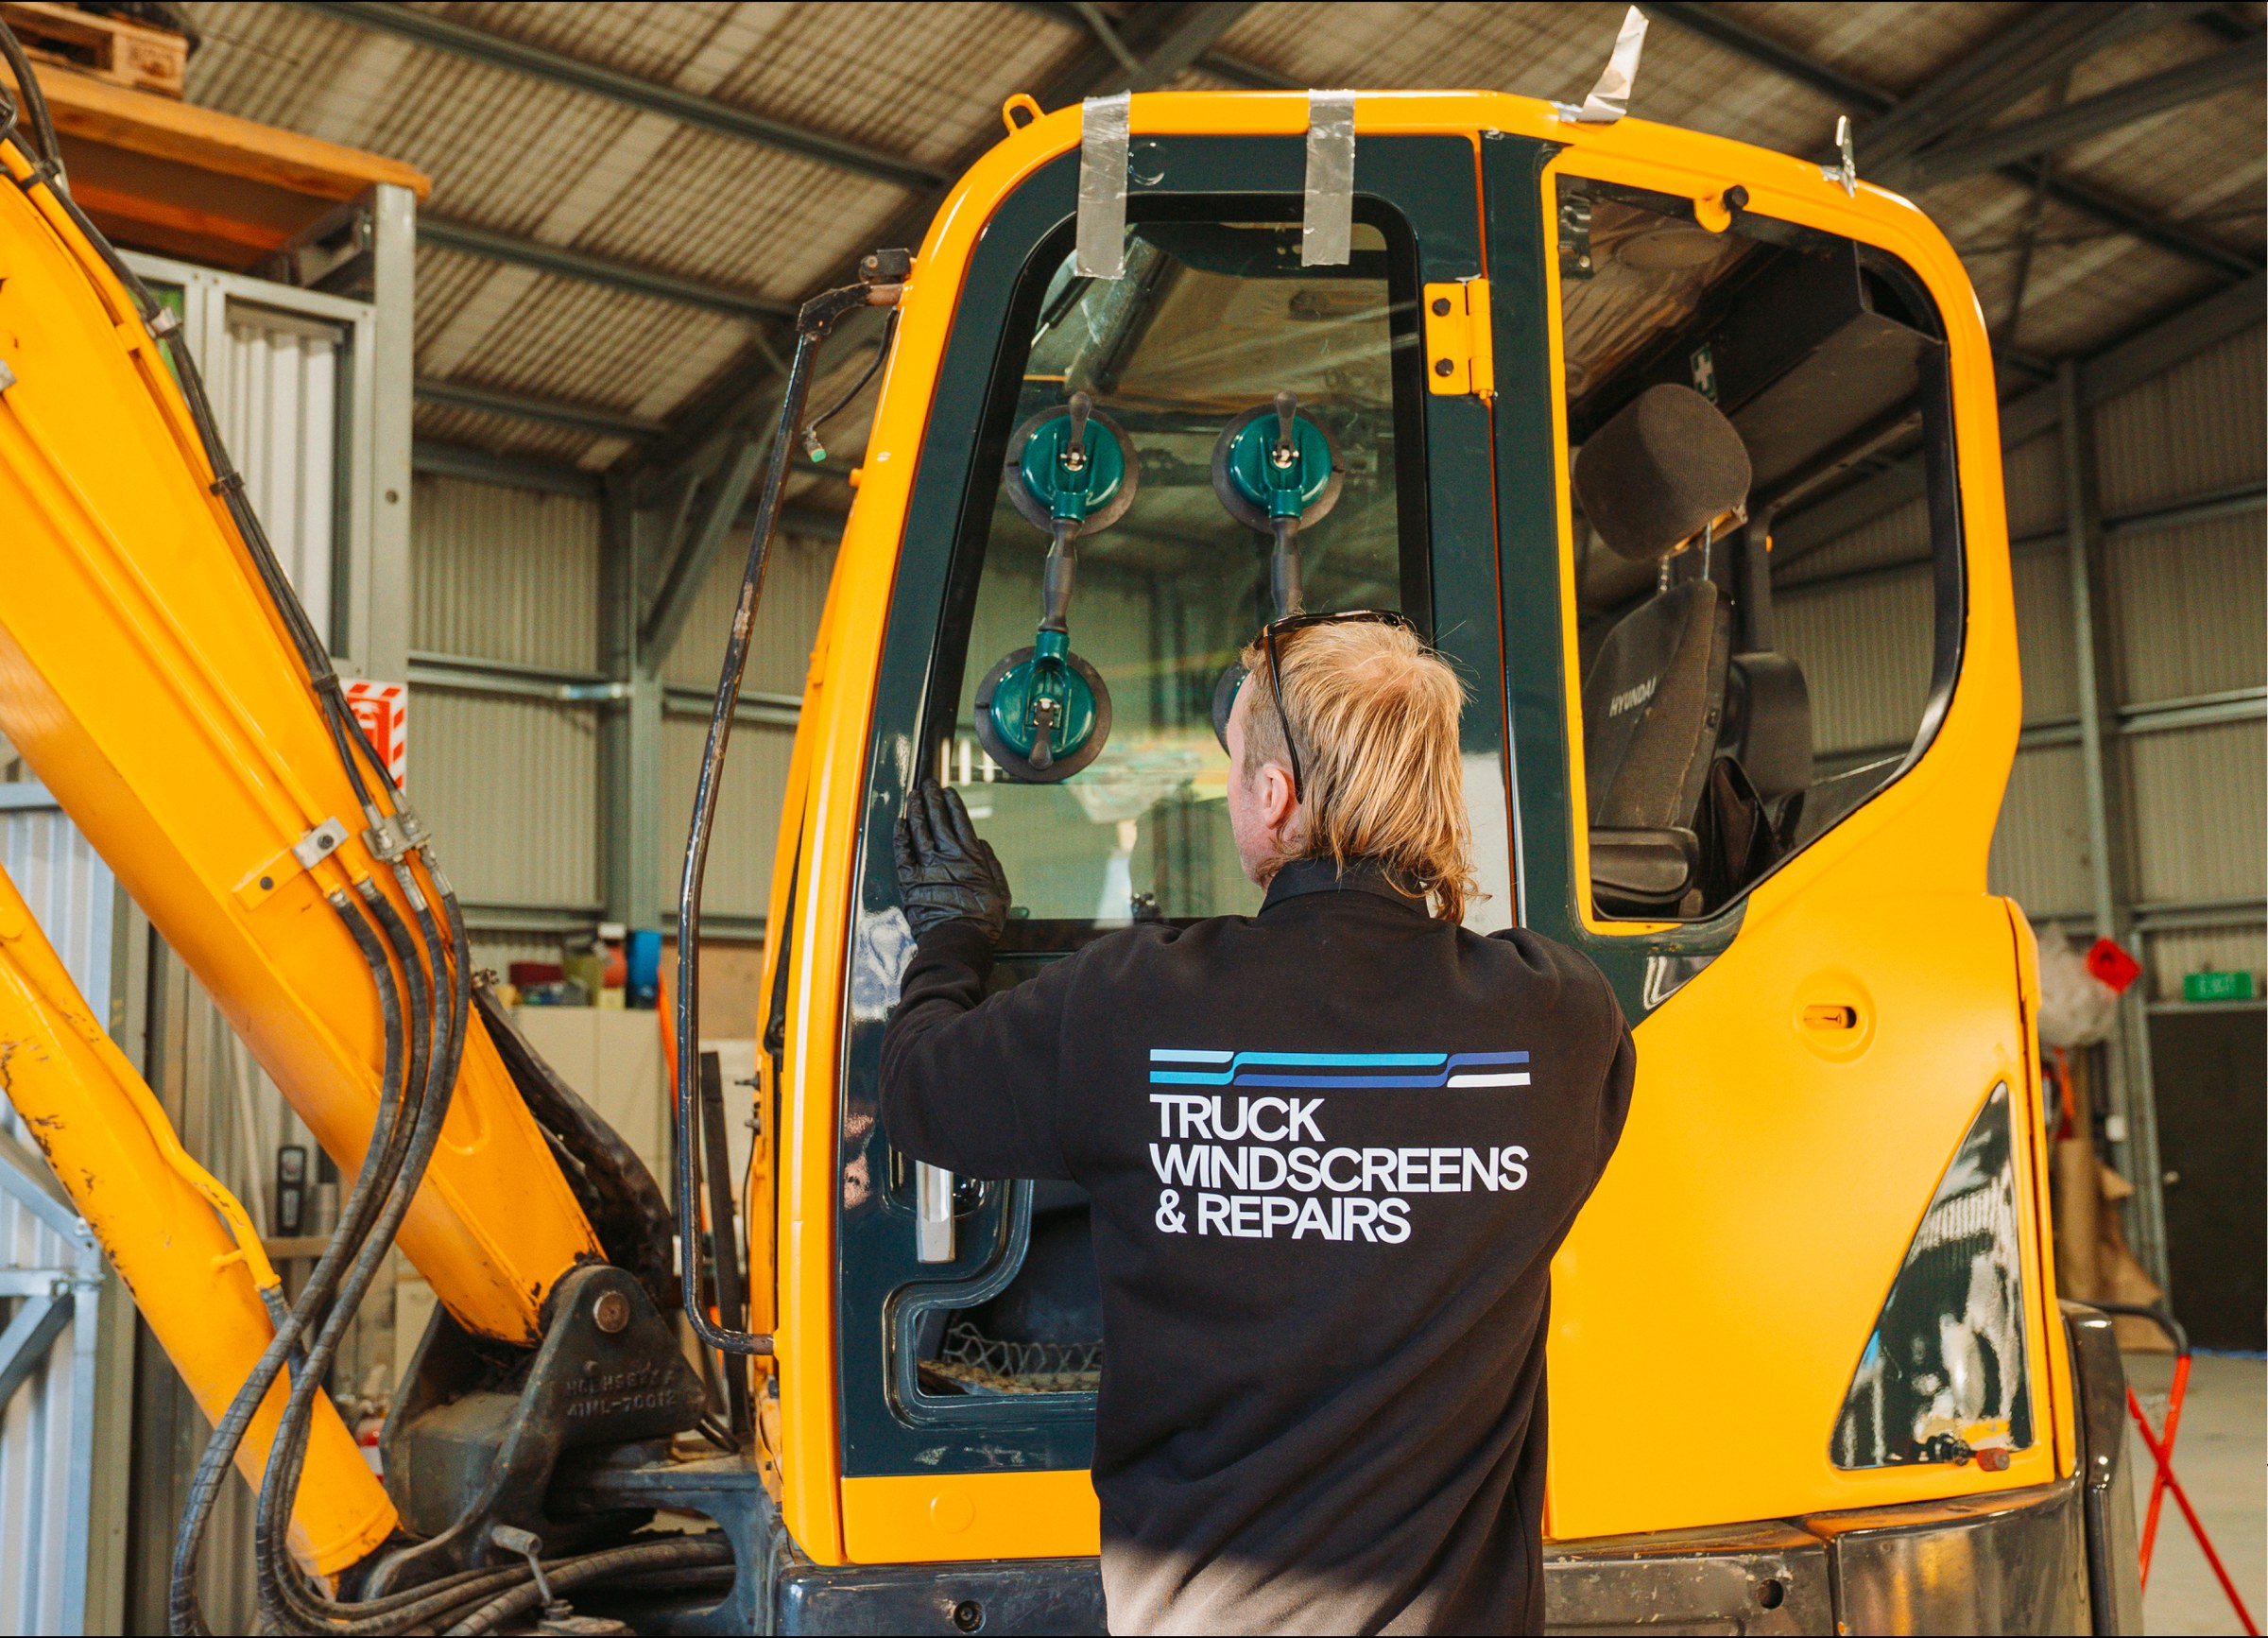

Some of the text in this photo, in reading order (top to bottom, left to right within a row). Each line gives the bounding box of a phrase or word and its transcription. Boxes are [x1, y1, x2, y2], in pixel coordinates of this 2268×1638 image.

[1608, 675, 1658, 717] HYUNDAI
[1149, 1094, 1325, 1142] TRUCK
[1149, 1143, 1529, 1192] WINDSCREENS
[1155, 1188, 1411, 1244] & REPAIRS
